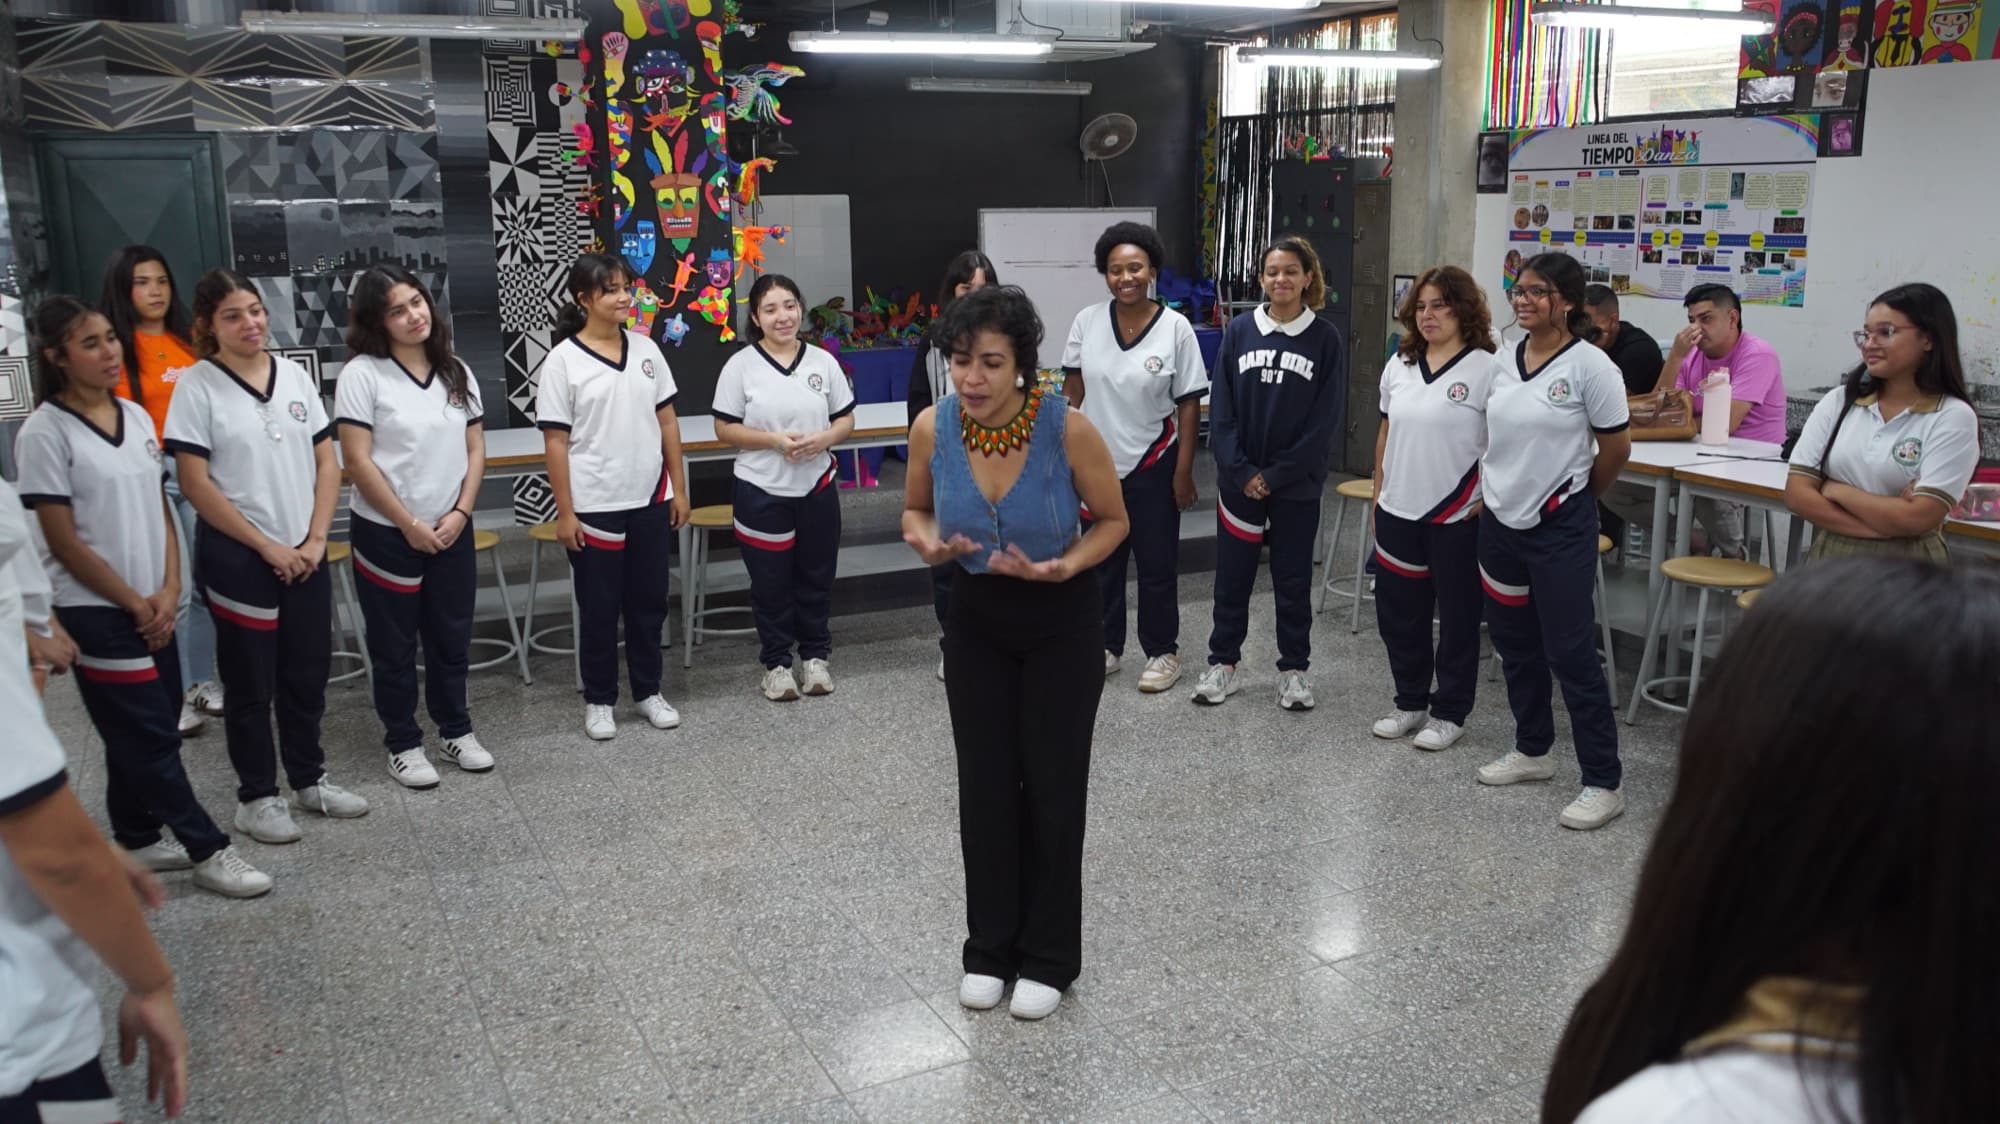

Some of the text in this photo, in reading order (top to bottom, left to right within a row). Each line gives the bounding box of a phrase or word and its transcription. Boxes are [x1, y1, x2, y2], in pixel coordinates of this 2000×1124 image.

[1587, 133, 1628, 144] LINEA DEL
[1582, 146, 1634, 165] TIEMPO
[1639, 148, 1698, 161] Danza
[1238, 349, 1314, 381] BABY GIRL
